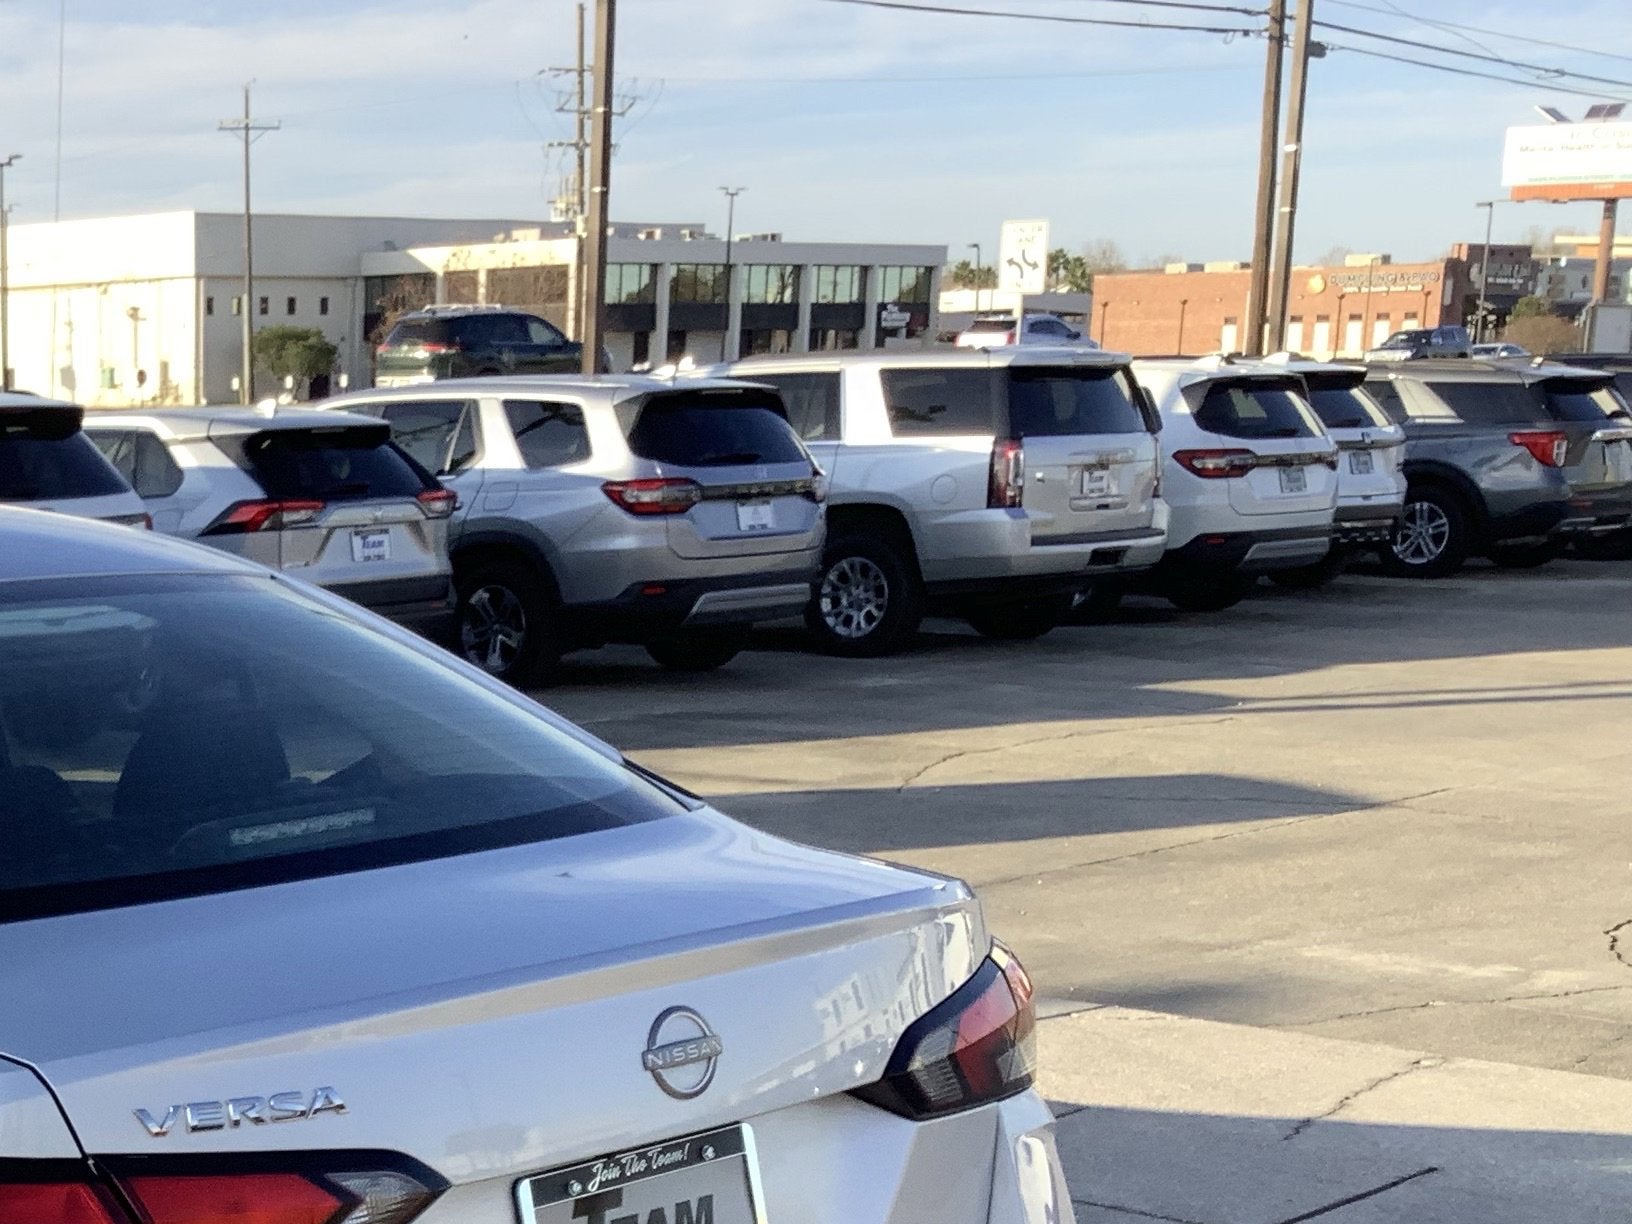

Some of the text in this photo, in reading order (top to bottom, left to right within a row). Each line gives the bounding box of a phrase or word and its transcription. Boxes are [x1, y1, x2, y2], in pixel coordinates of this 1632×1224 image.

[647, 1039, 722, 1067] NISSAN
[134, 1086, 349, 1137] VERSA
[588, 1143, 690, 1192] Join The Team!
